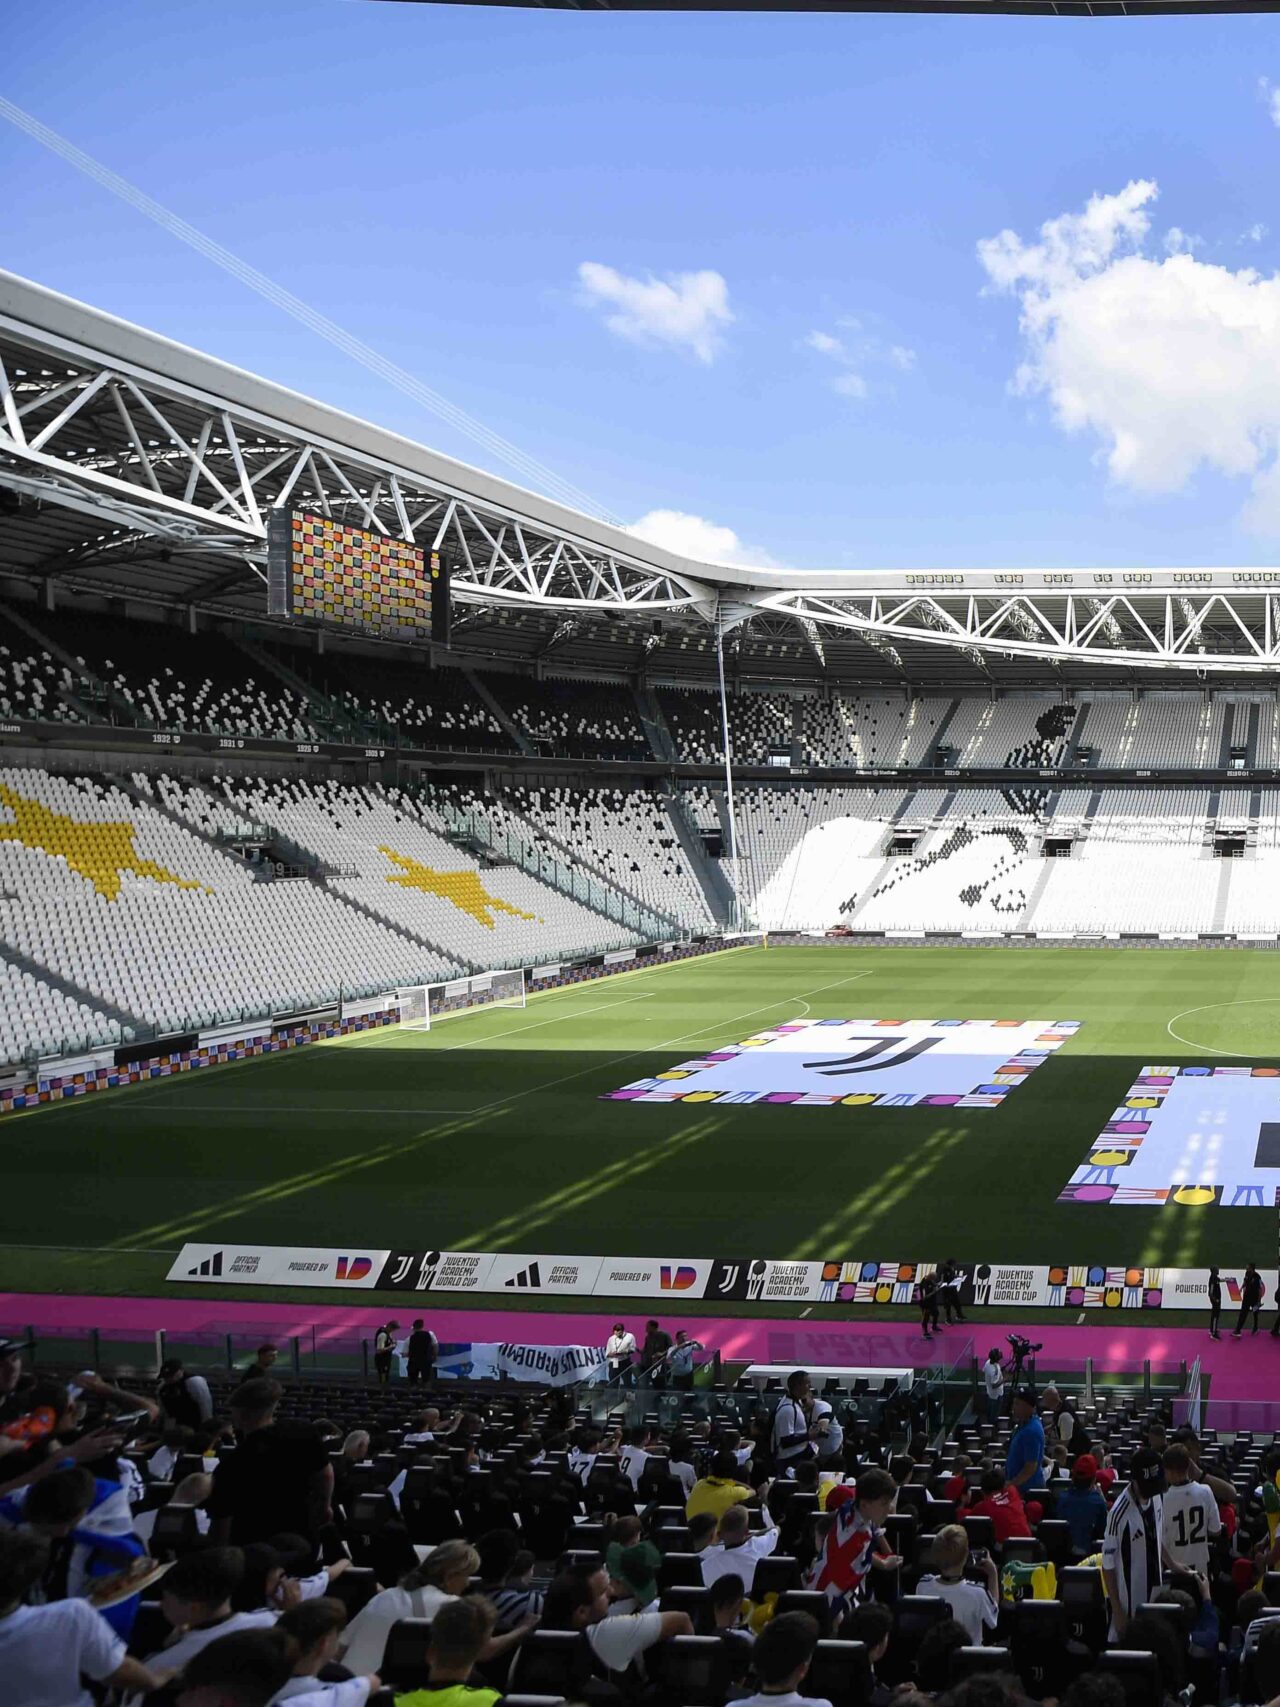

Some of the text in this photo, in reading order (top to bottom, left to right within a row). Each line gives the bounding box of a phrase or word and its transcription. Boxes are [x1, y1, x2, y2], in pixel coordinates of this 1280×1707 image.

[152, 734, 171, 744] 1932
[235, 1256, 261, 1265] OFFICIAL
[444, 1257, 480, 1267] JUVENTUS
[230, 1264, 259, 1273] PARTNER
[288, 1262, 329, 1272] POWERED BY
[440, 1267, 475, 1277] ACADEMY
[551, 1266, 579, 1275] OFFICIAL
[771, 1265, 808, 1275] JUVENTUS
[548, 1275, 578, 1284] PARTNER
[609, 1272, 652, 1282] POWERED BY
[769, 1275, 805, 1285] ACADEMY
[996, 1270, 1034, 1280] JUVENTUS
[436, 1277, 478, 1287] WORLD CUP
[995, 1280, 1031, 1290] ACADEMY
[766, 1285, 810, 1296] WORLD CUP
[1175, 1284, 1208, 1294] POWERED
[993, 1291, 1037, 1301] WORLD CUP
[1173, 1505, 1206, 1547] 12
